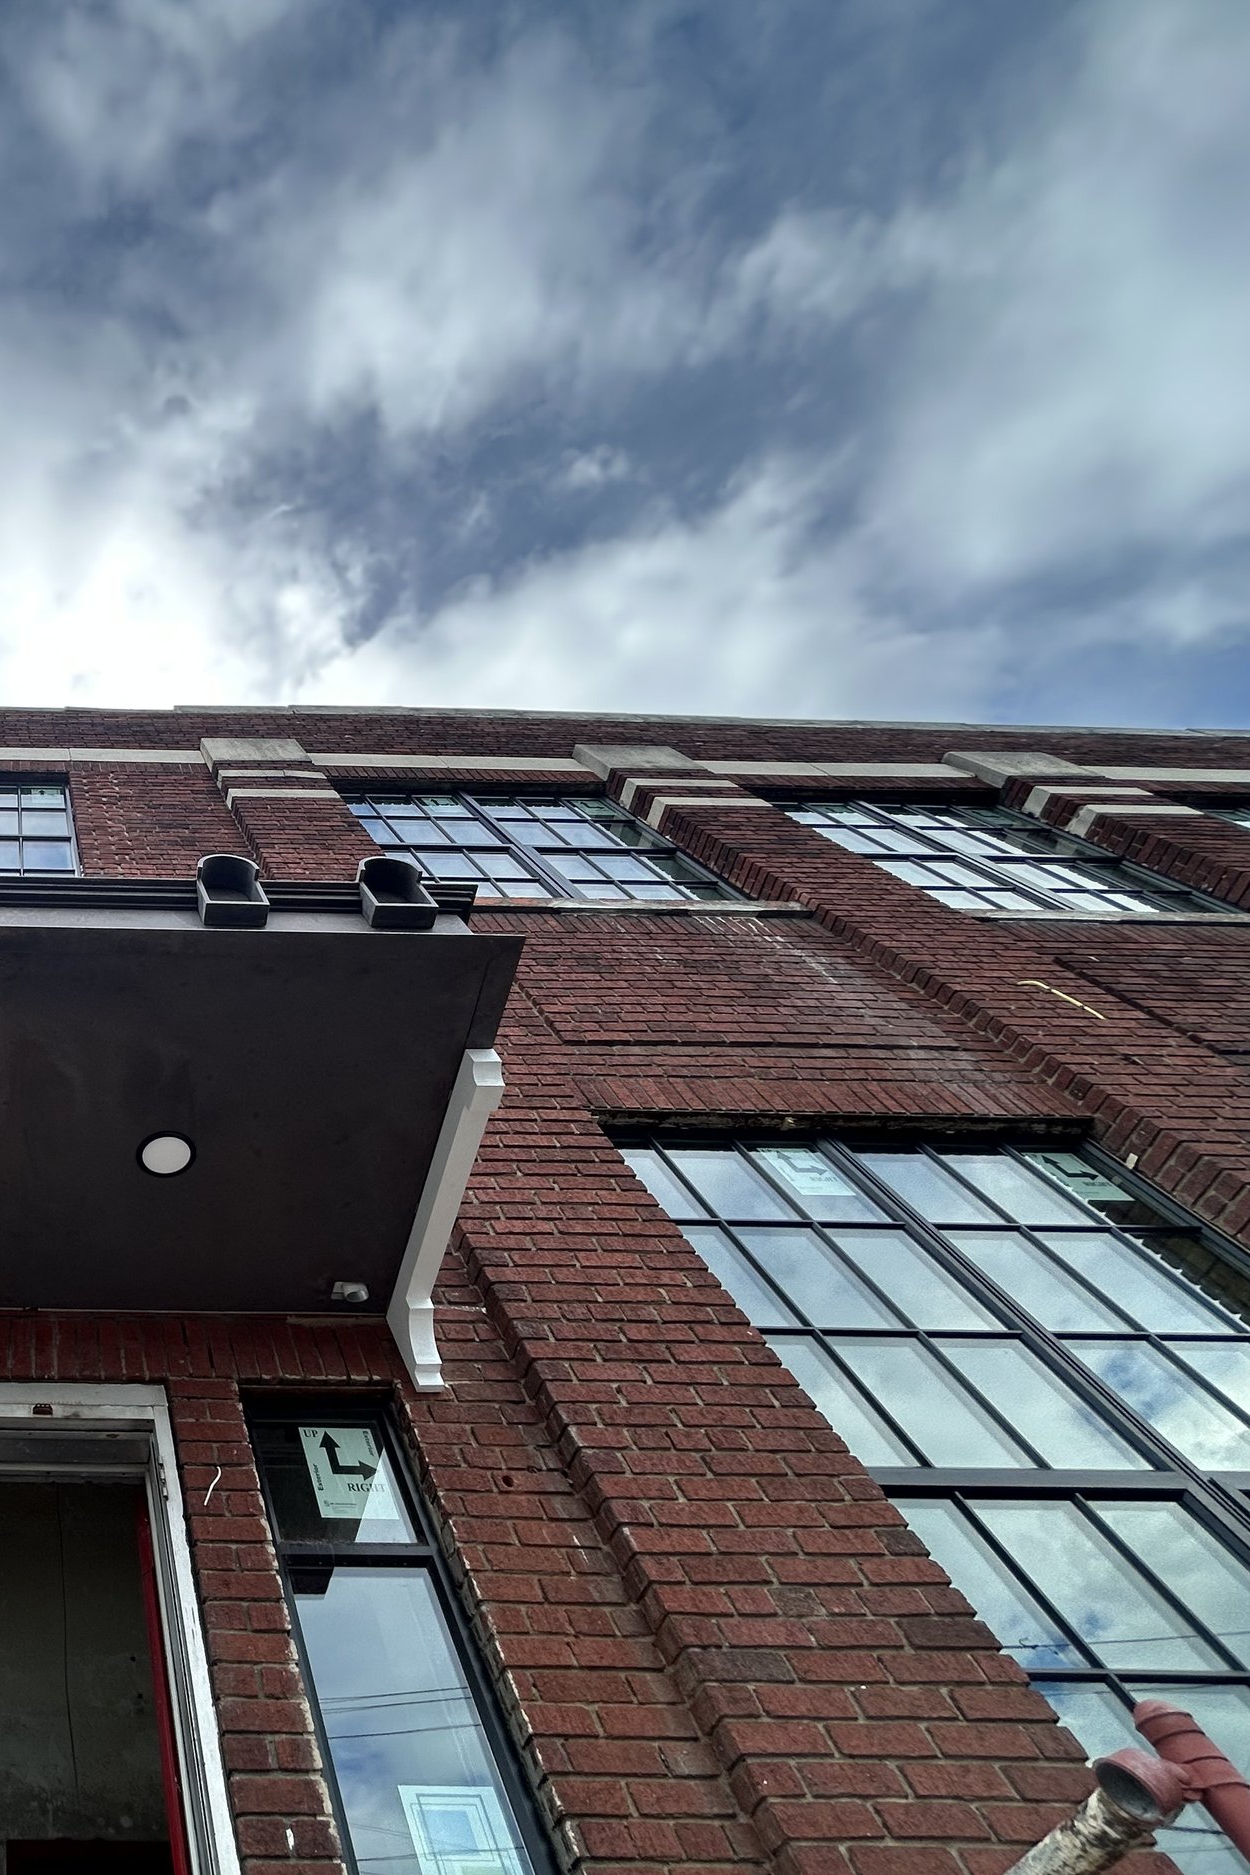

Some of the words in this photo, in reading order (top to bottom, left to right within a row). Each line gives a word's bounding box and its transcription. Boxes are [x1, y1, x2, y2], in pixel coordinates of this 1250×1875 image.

[303, 1429, 318, 1438] UP
[313, 1463, 324, 1491] Exterior
[347, 1483, 386, 1492] RIGHT
